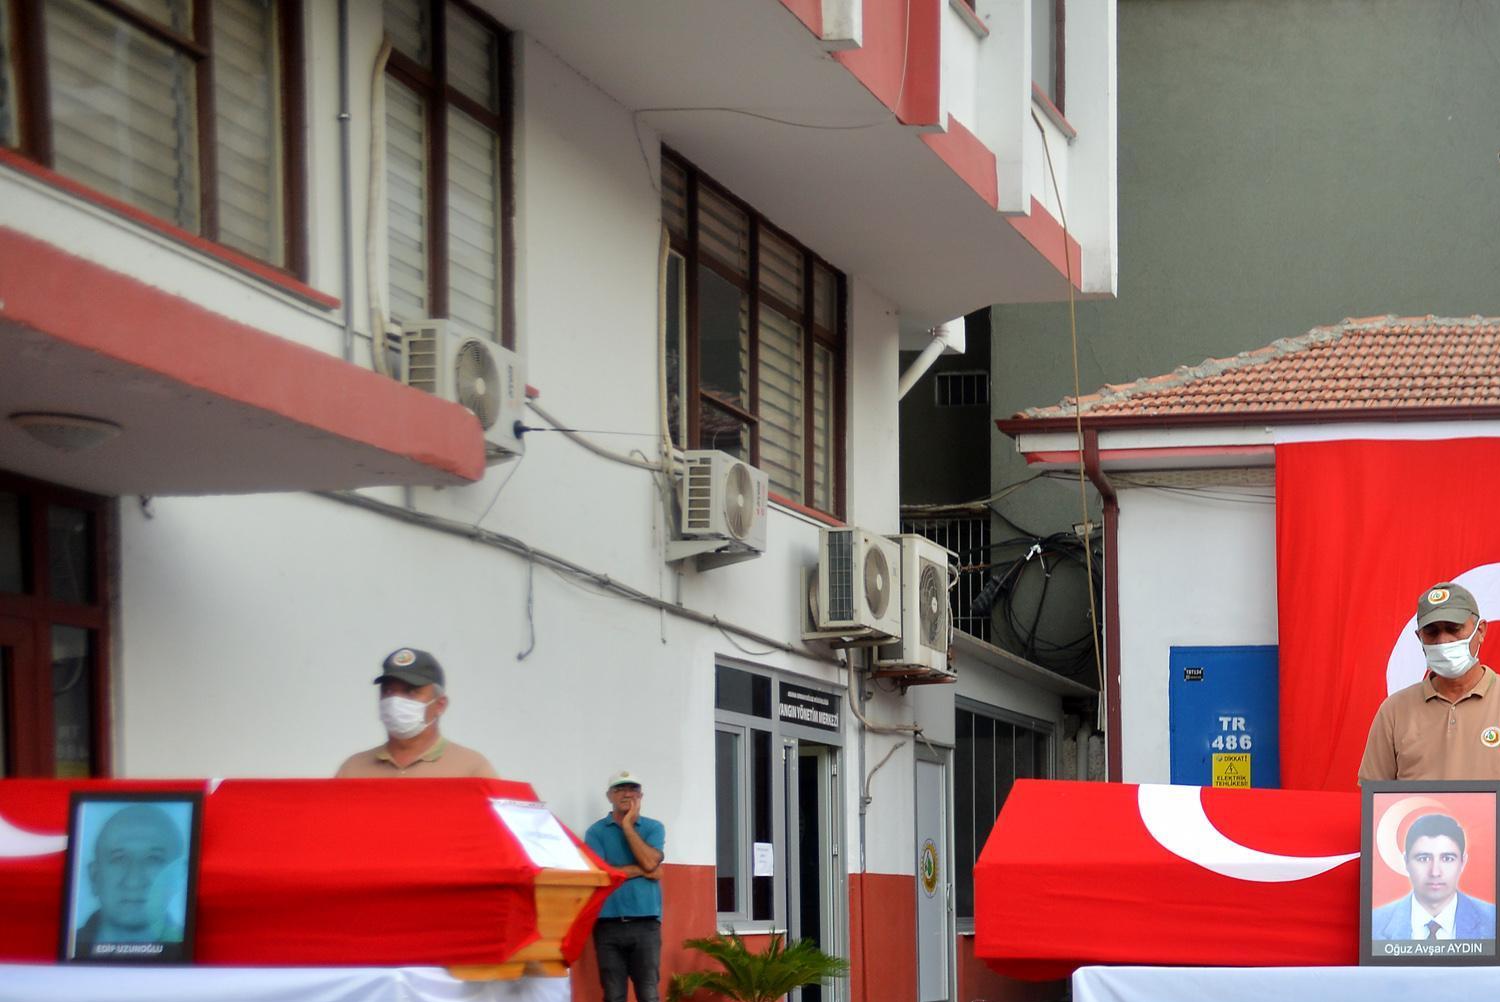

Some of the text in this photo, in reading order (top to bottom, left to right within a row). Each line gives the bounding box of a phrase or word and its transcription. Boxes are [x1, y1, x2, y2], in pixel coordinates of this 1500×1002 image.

[779, 703, 839, 728] YANGIN YÖNETİM MERKEZİ
[1218, 716, 1246, 731] TR
[1211, 734, 1252, 750] 486
[1384, 943, 1483, 956] Oğuz Avşar AYDIN
